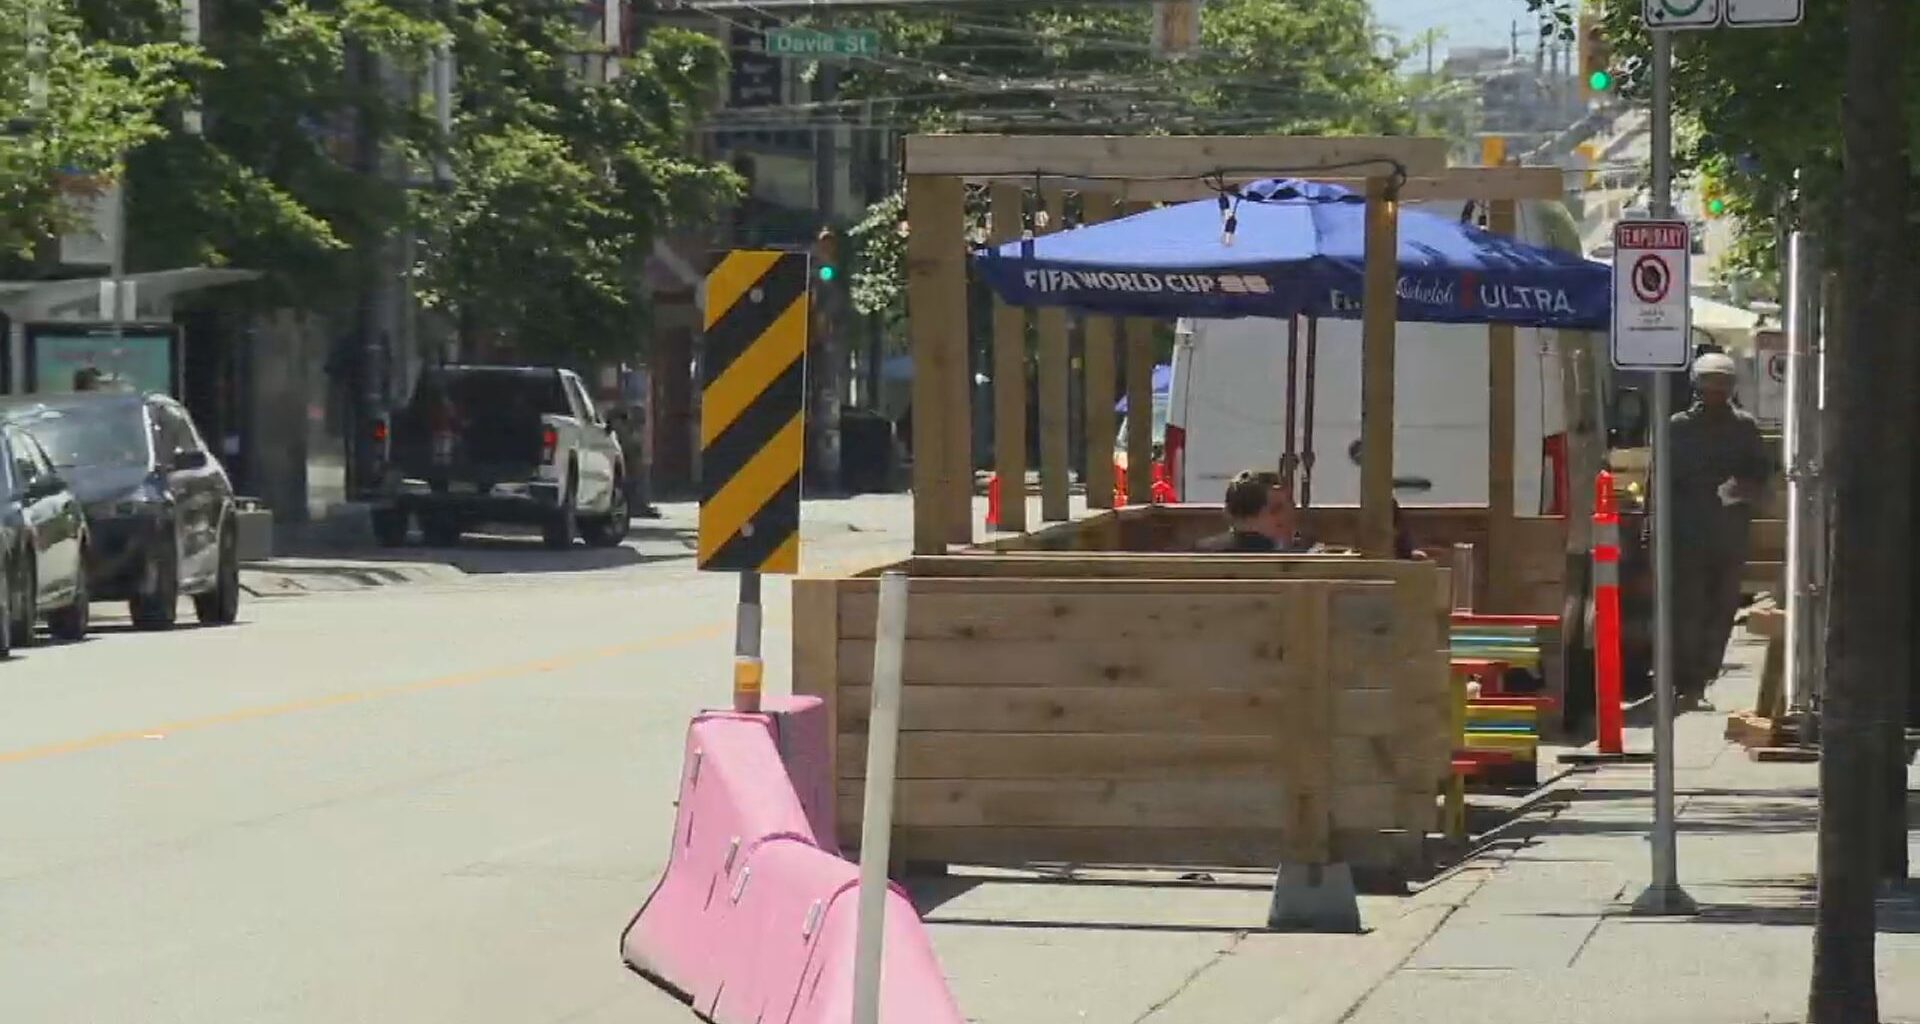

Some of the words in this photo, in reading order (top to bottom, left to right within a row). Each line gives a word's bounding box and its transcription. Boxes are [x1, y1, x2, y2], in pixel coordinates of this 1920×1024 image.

[778, 35, 834, 52] Davie
[845, 36, 867, 52] St
[1023, 269, 1082, 293] FIFA
[1080, 271, 1162, 293] WORLD
[1164, 273, 1214, 293] CUP
[1479, 283, 1573, 313] ULTRA
